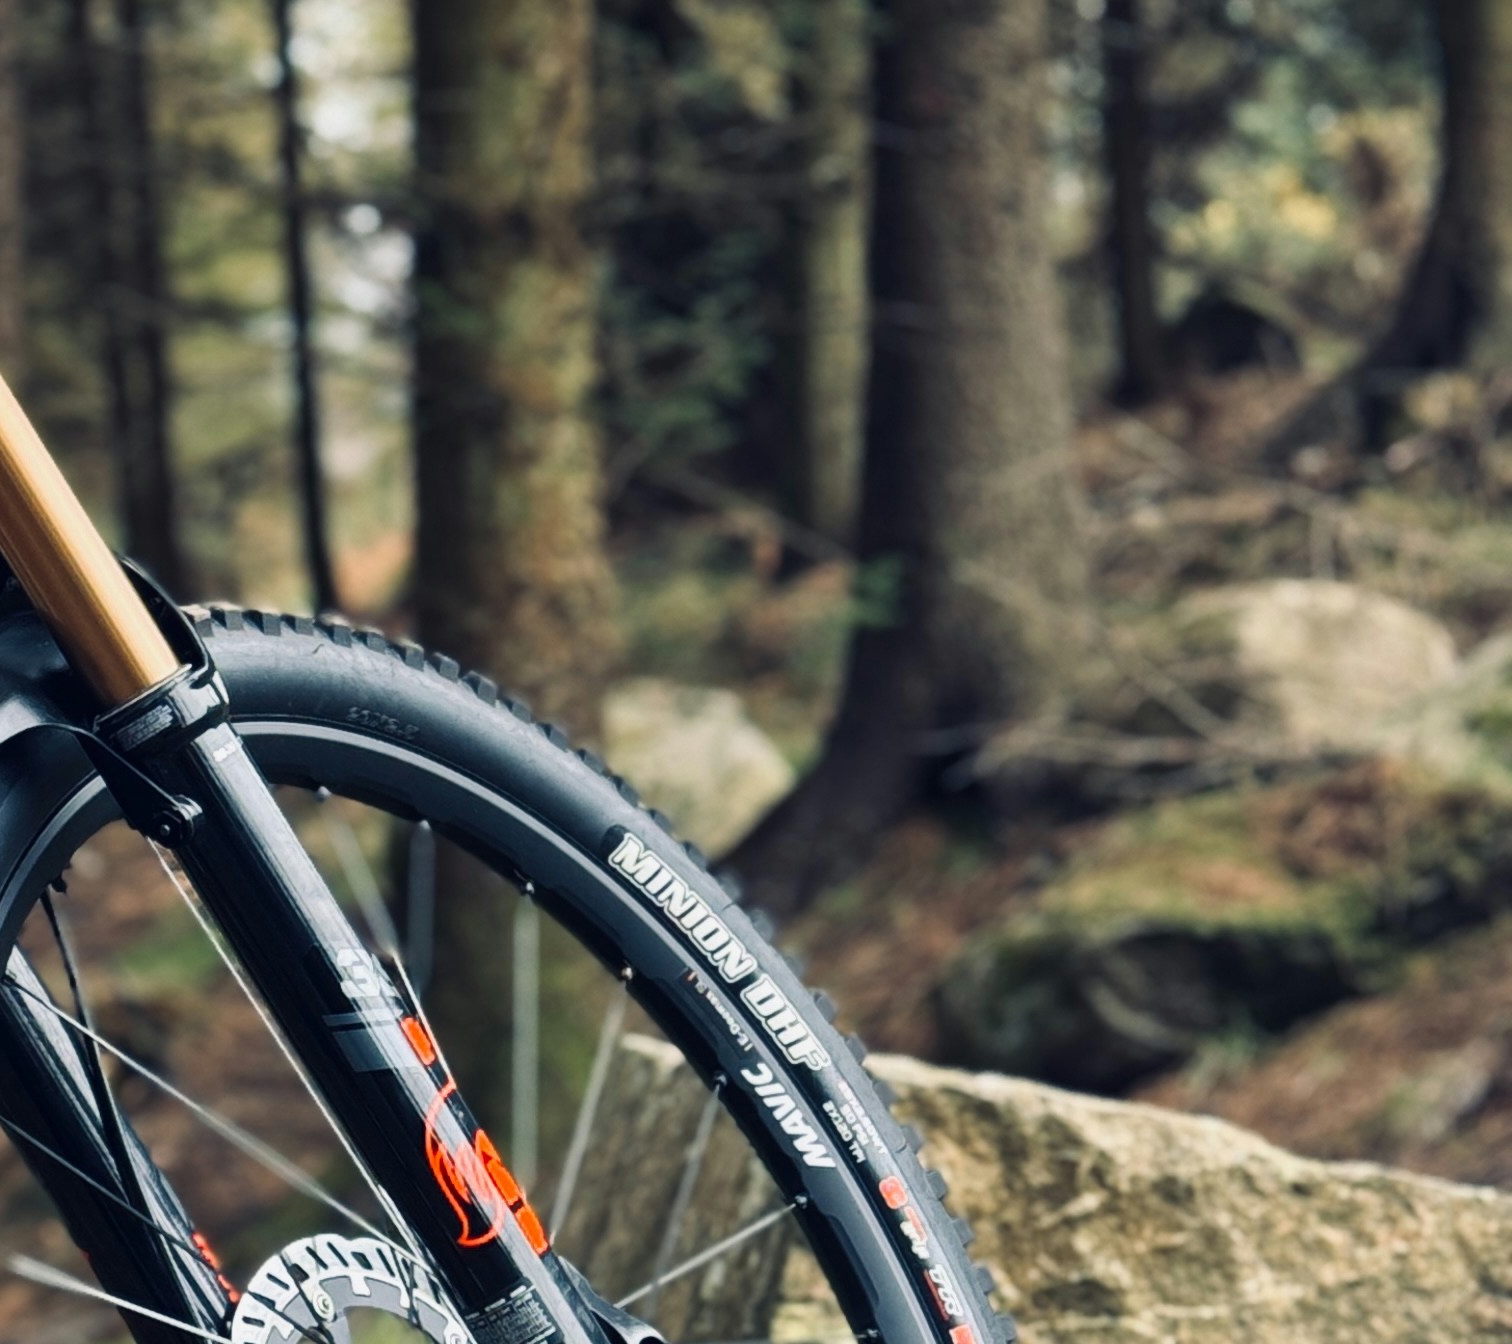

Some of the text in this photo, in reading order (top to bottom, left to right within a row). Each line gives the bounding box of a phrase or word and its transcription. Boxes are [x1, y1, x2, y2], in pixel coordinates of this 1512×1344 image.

[608, 832, 832, 1070] MINION DHF
[742, 1063, 836, 1168] MAVIC
